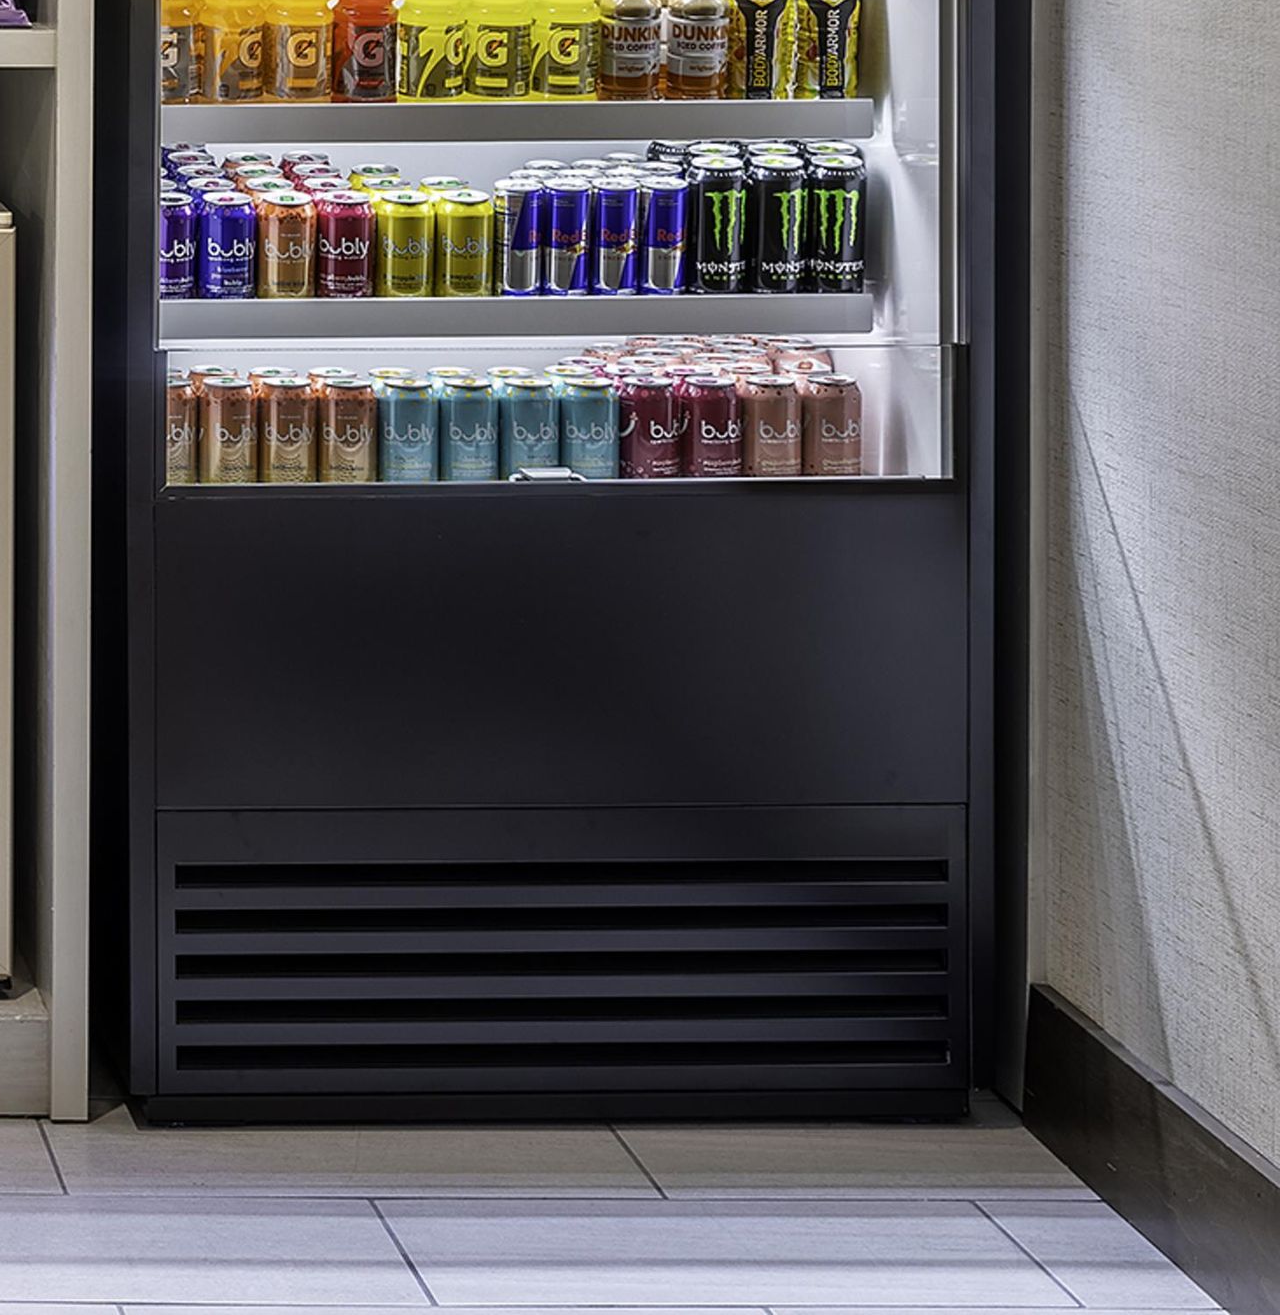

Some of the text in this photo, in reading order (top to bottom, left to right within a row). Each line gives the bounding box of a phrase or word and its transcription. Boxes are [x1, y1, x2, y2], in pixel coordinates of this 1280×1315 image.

[476, 32, 508, 66] G
[549, 29, 580, 65] G
[753, 9, 768, 87] BODYARMOR
[826, 8, 840, 87] BODYARMOR
[207, 237, 256, 259] bubly
[319, 235, 370, 259] bubly
